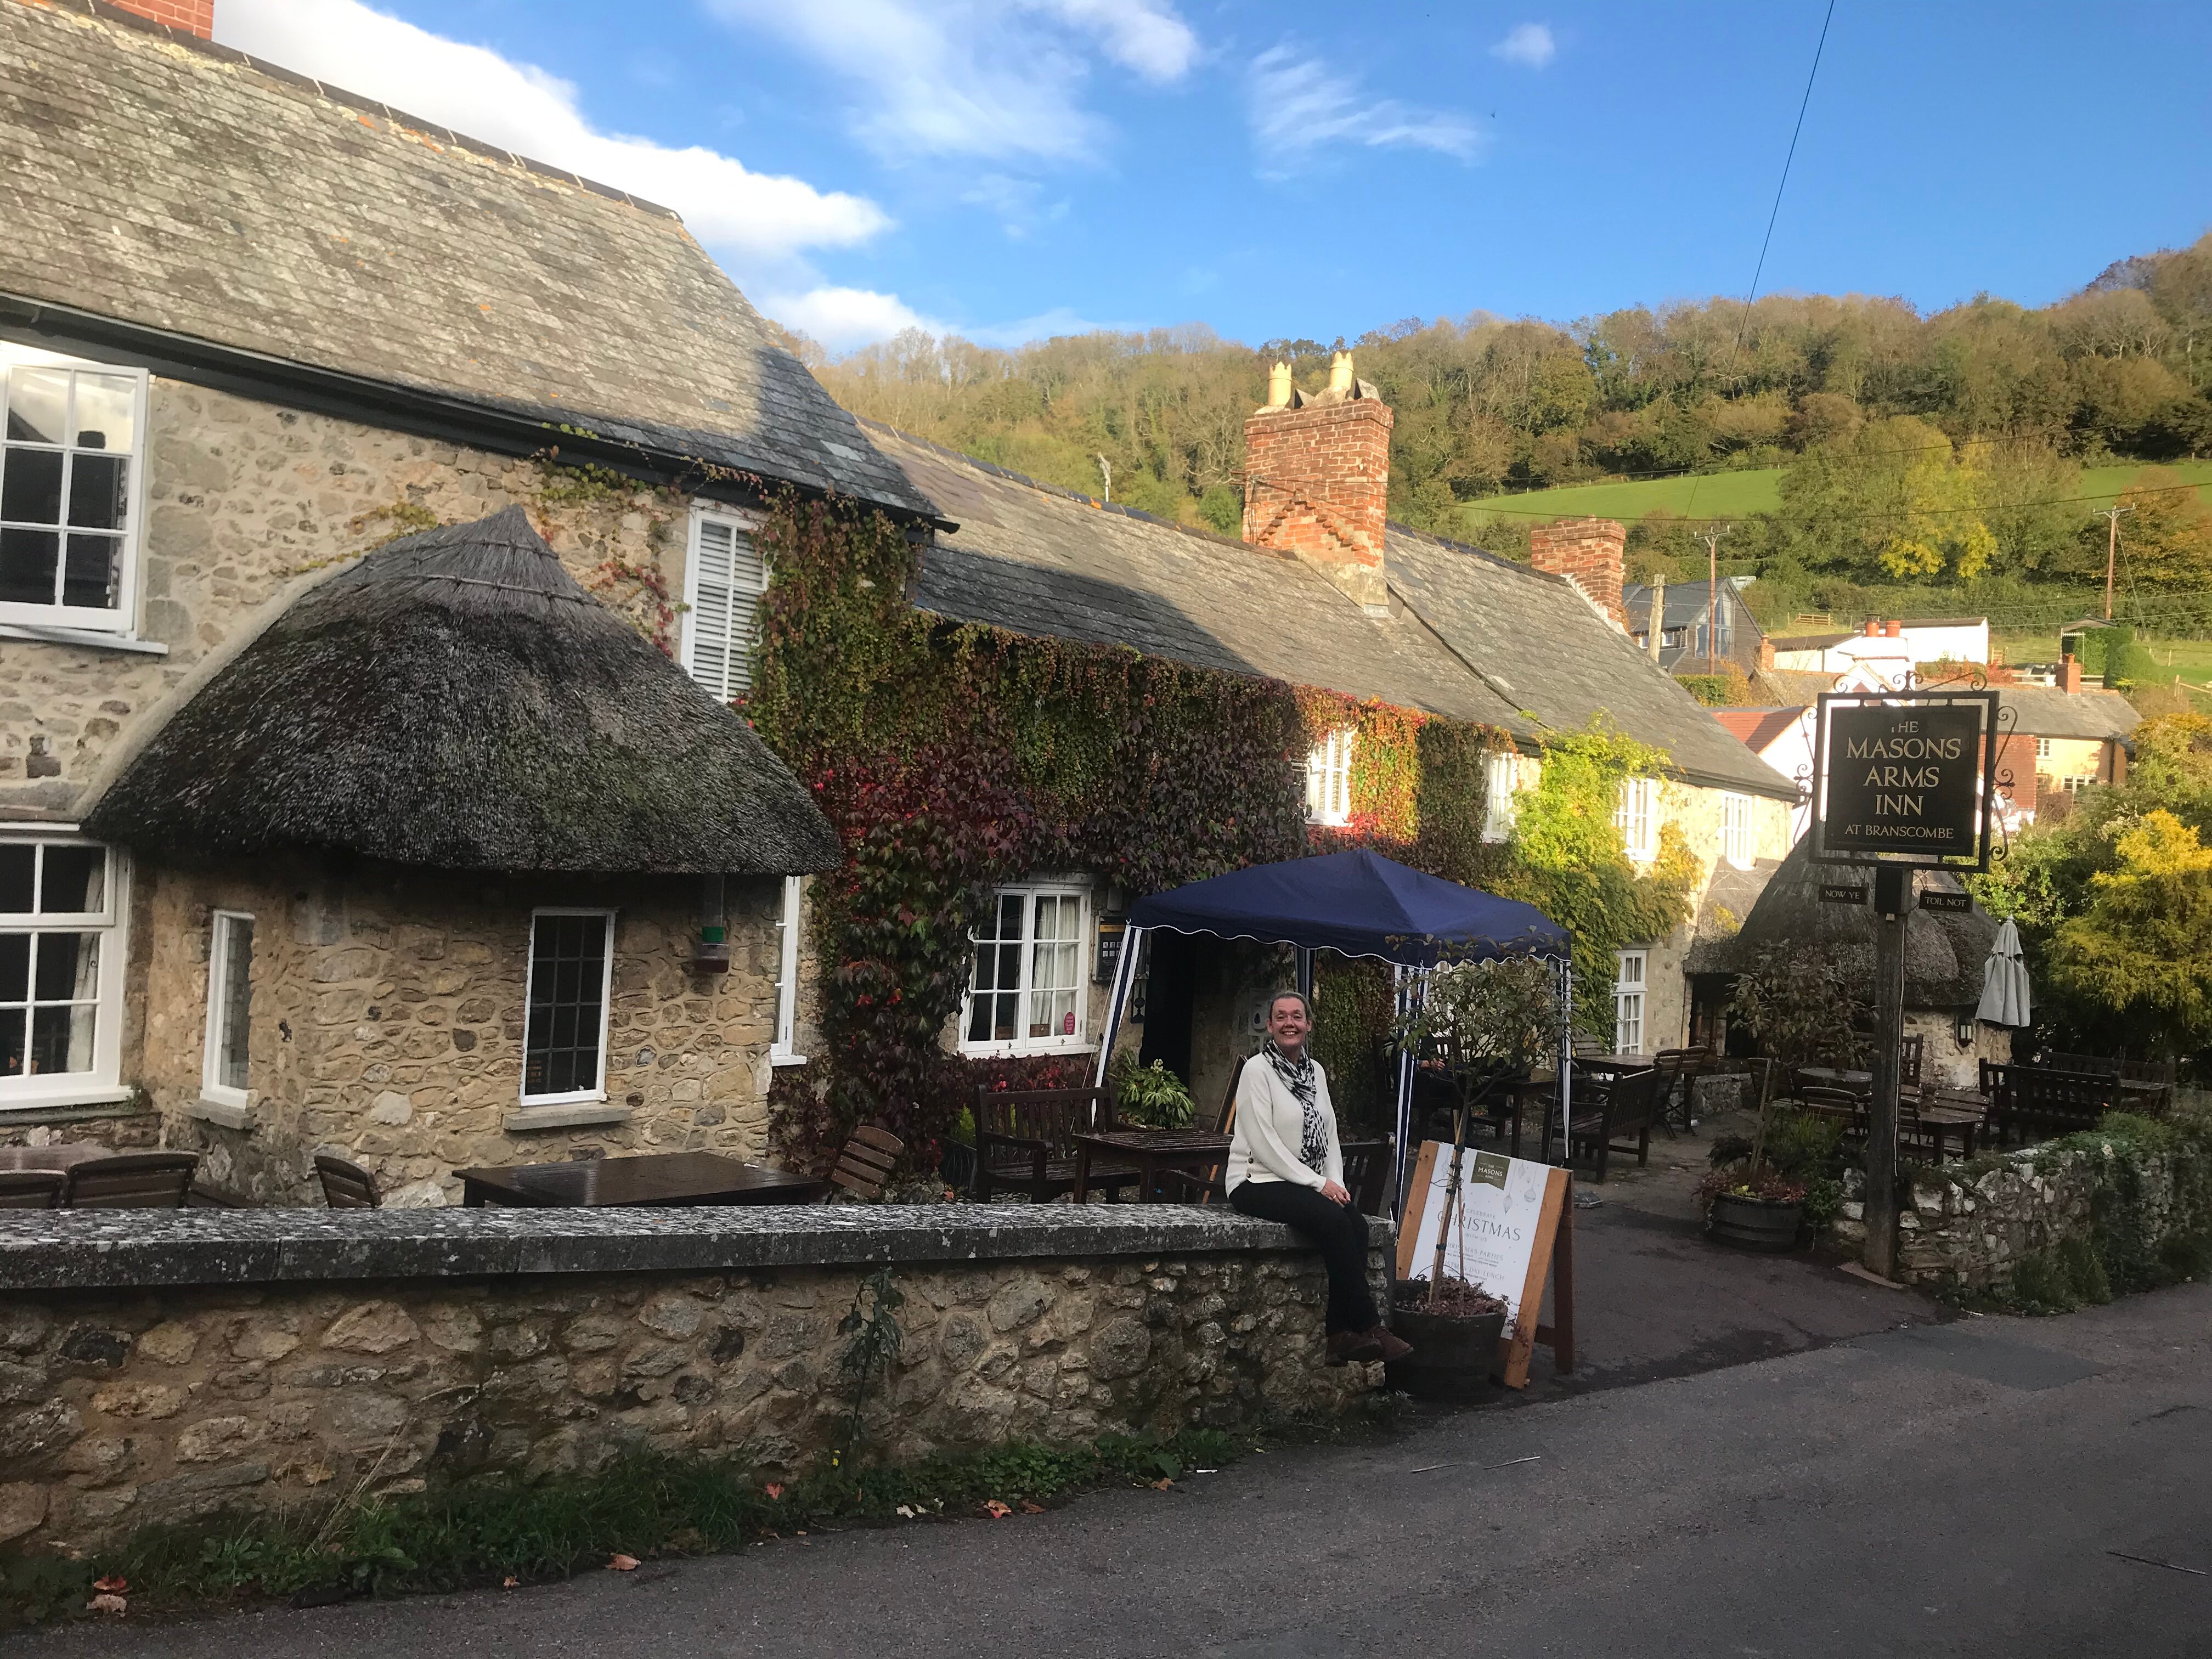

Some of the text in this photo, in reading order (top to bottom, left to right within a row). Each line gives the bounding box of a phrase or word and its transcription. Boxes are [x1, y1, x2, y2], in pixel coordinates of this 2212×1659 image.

[1846, 737, 1961, 759] MASONS
[1863, 765, 1940, 788] ARMS
[1875, 794, 1924, 816] INN
[1844, 824, 1954, 839] AT BRANSCOMBE
[1825, 889, 1860, 900] NOW YE
[1925, 896, 1944, 906] TOIL
[1477, 1166, 1503, 1177] MASONS
[1466, 1208, 1496, 1220] CELEBRATE
[1480, 1250, 1504, 1261] PARTIES
